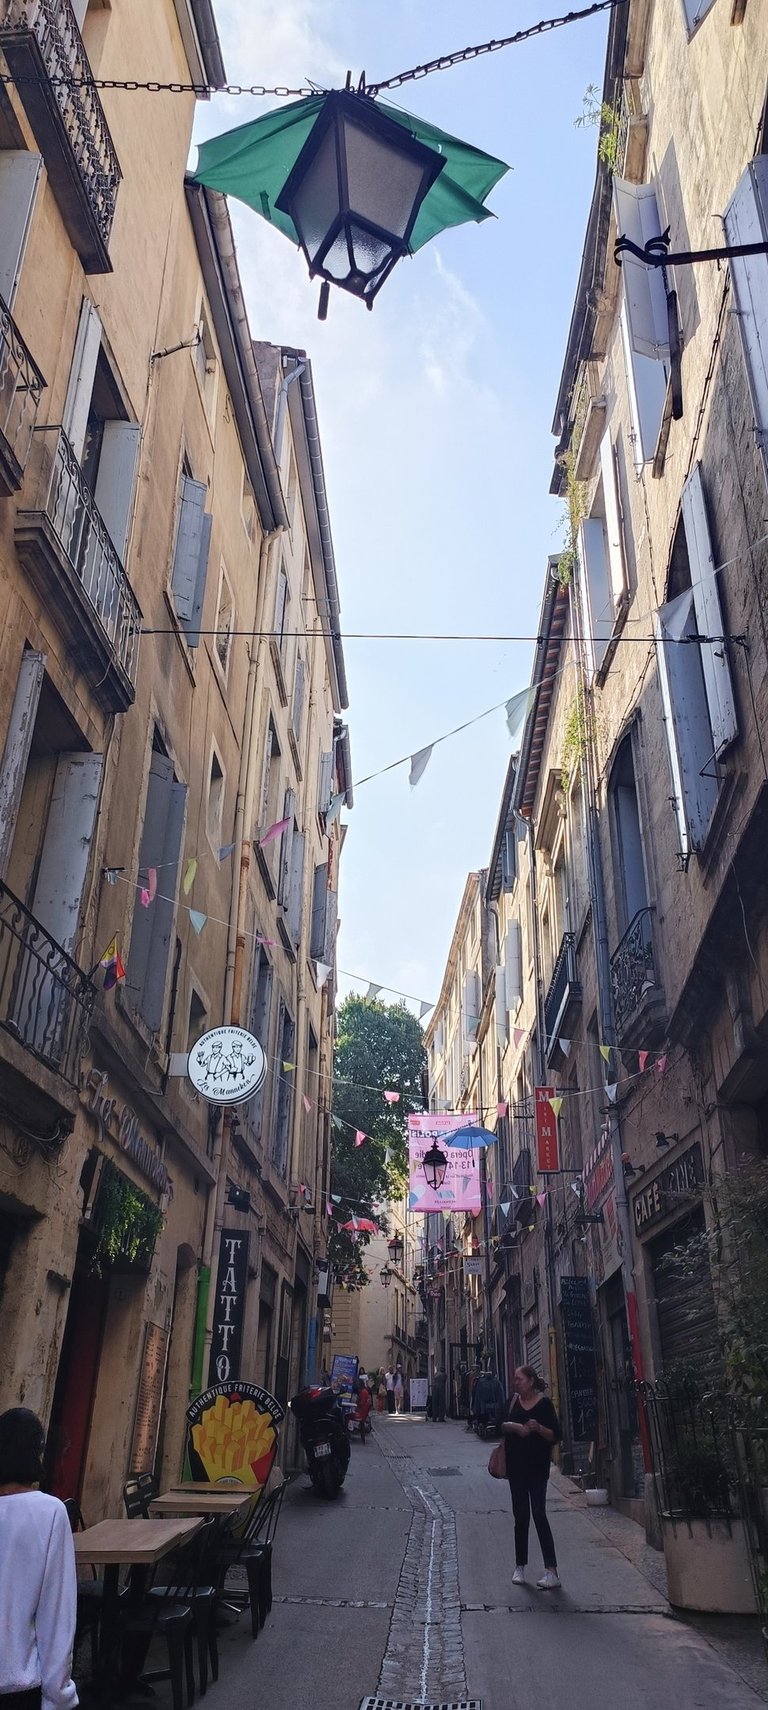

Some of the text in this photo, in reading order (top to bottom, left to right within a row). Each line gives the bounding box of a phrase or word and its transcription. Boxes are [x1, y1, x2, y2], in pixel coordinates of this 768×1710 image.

[199, 1029, 257, 1049] AUTHENTIQUE FRITERIE BELGE
[188, 1383, 282, 1420] AUTHENTIQUE FRITERIE BELGE
